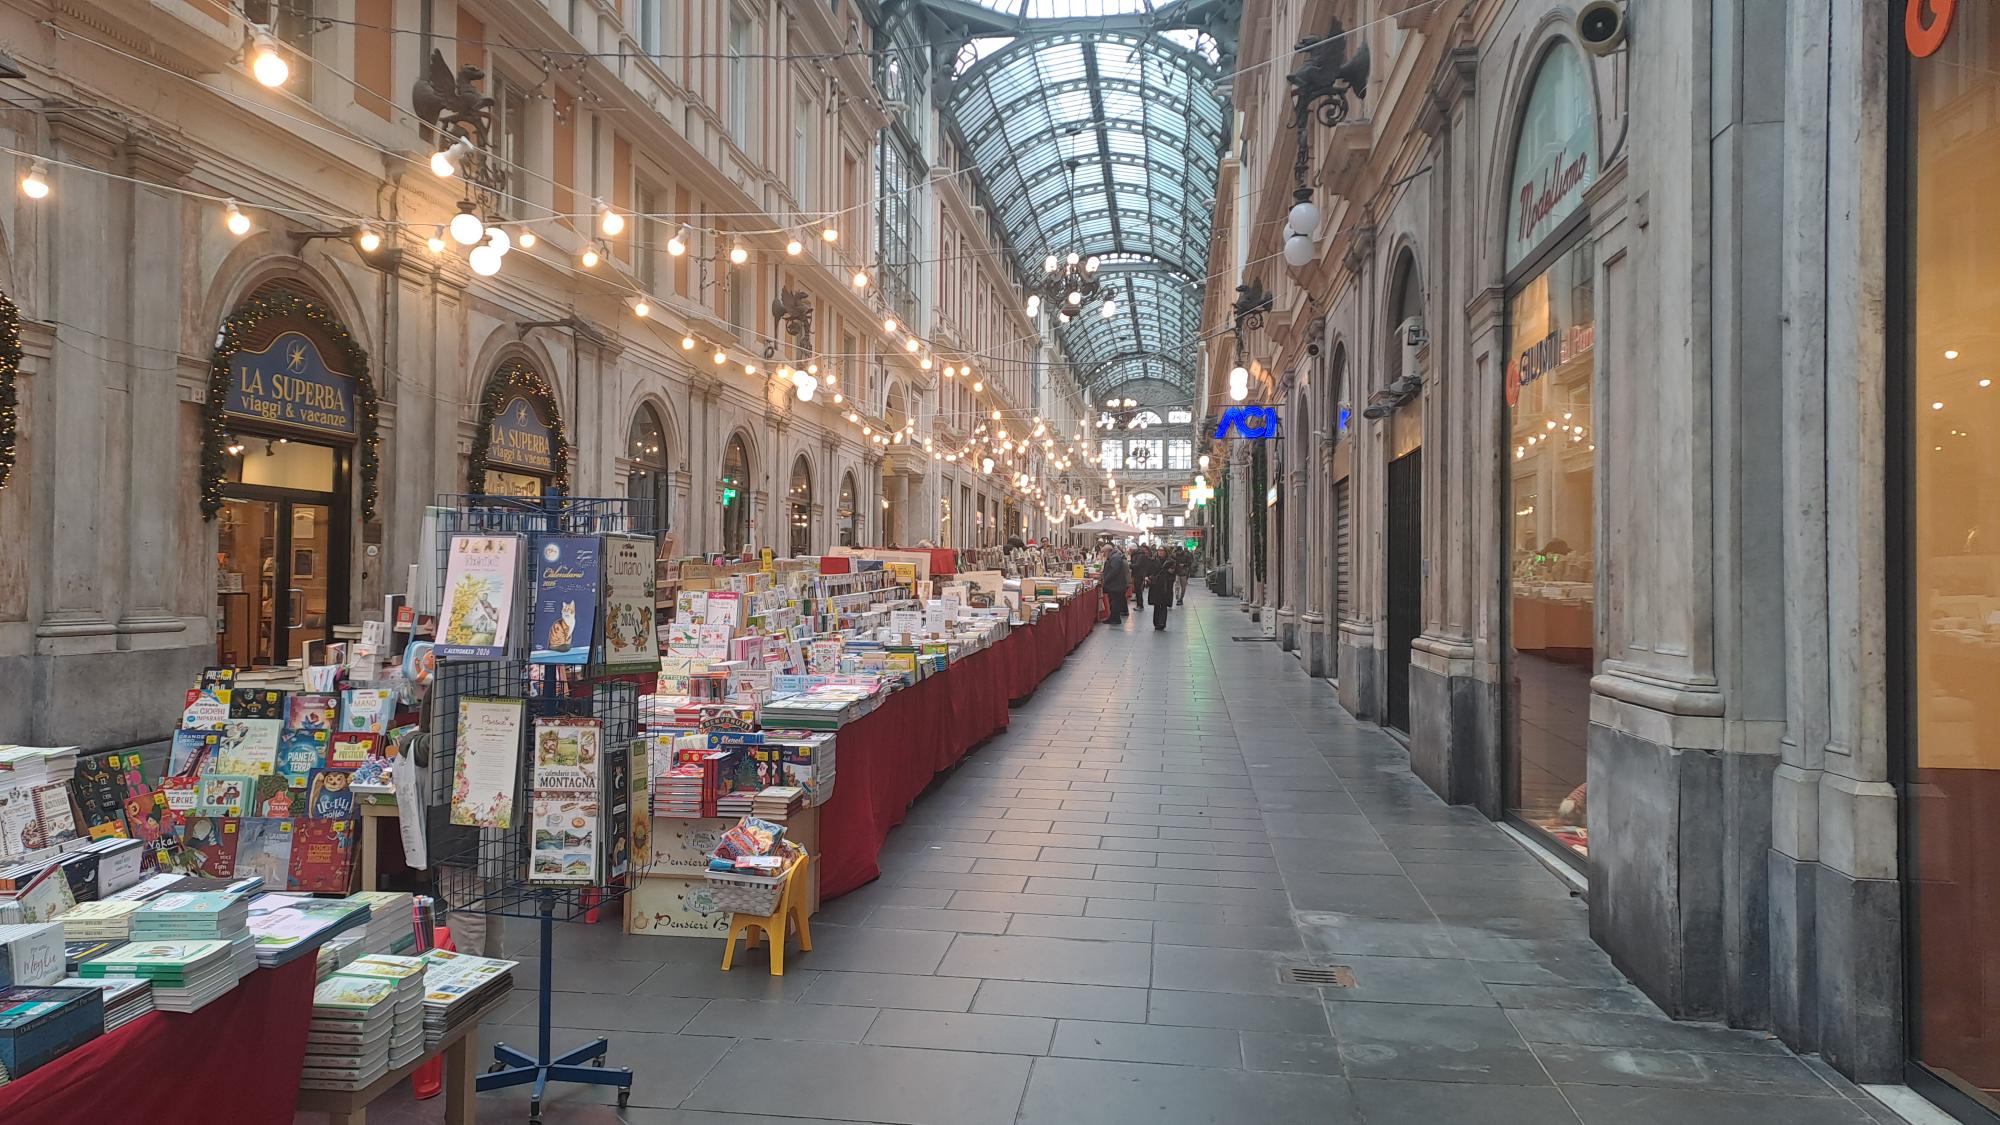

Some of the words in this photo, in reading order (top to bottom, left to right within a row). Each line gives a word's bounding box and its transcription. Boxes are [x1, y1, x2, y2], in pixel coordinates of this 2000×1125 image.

[1518, 147, 1587, 243] Modellismo
[1520, 328, 1561, 386] GIUNTI
[241, 366, 265, 396] LA
[271, 373, 345, 412] SUPERBA
[241, 395, 281, 419] viaggi
[285, 402, 295, 418] &
[300, 408, 346, 427] vacanze
[1215, 405, 1278, 439] ACI
[490, 424, 505, 445] LA
[508, 428, 551, 455] SUPERBA
[492, 445, 515, 463] viaggi
[443, 647, 475, 655] CALENDARIO
[703, 716, 750, 729] BENVENUTI
[287, 751, 316, 760] PIANETA
[290, 761, 311, 772] TERRA
[540, 776, 596, 788] MONTAGNA
[654, 912, 709, 930] Pensieri
